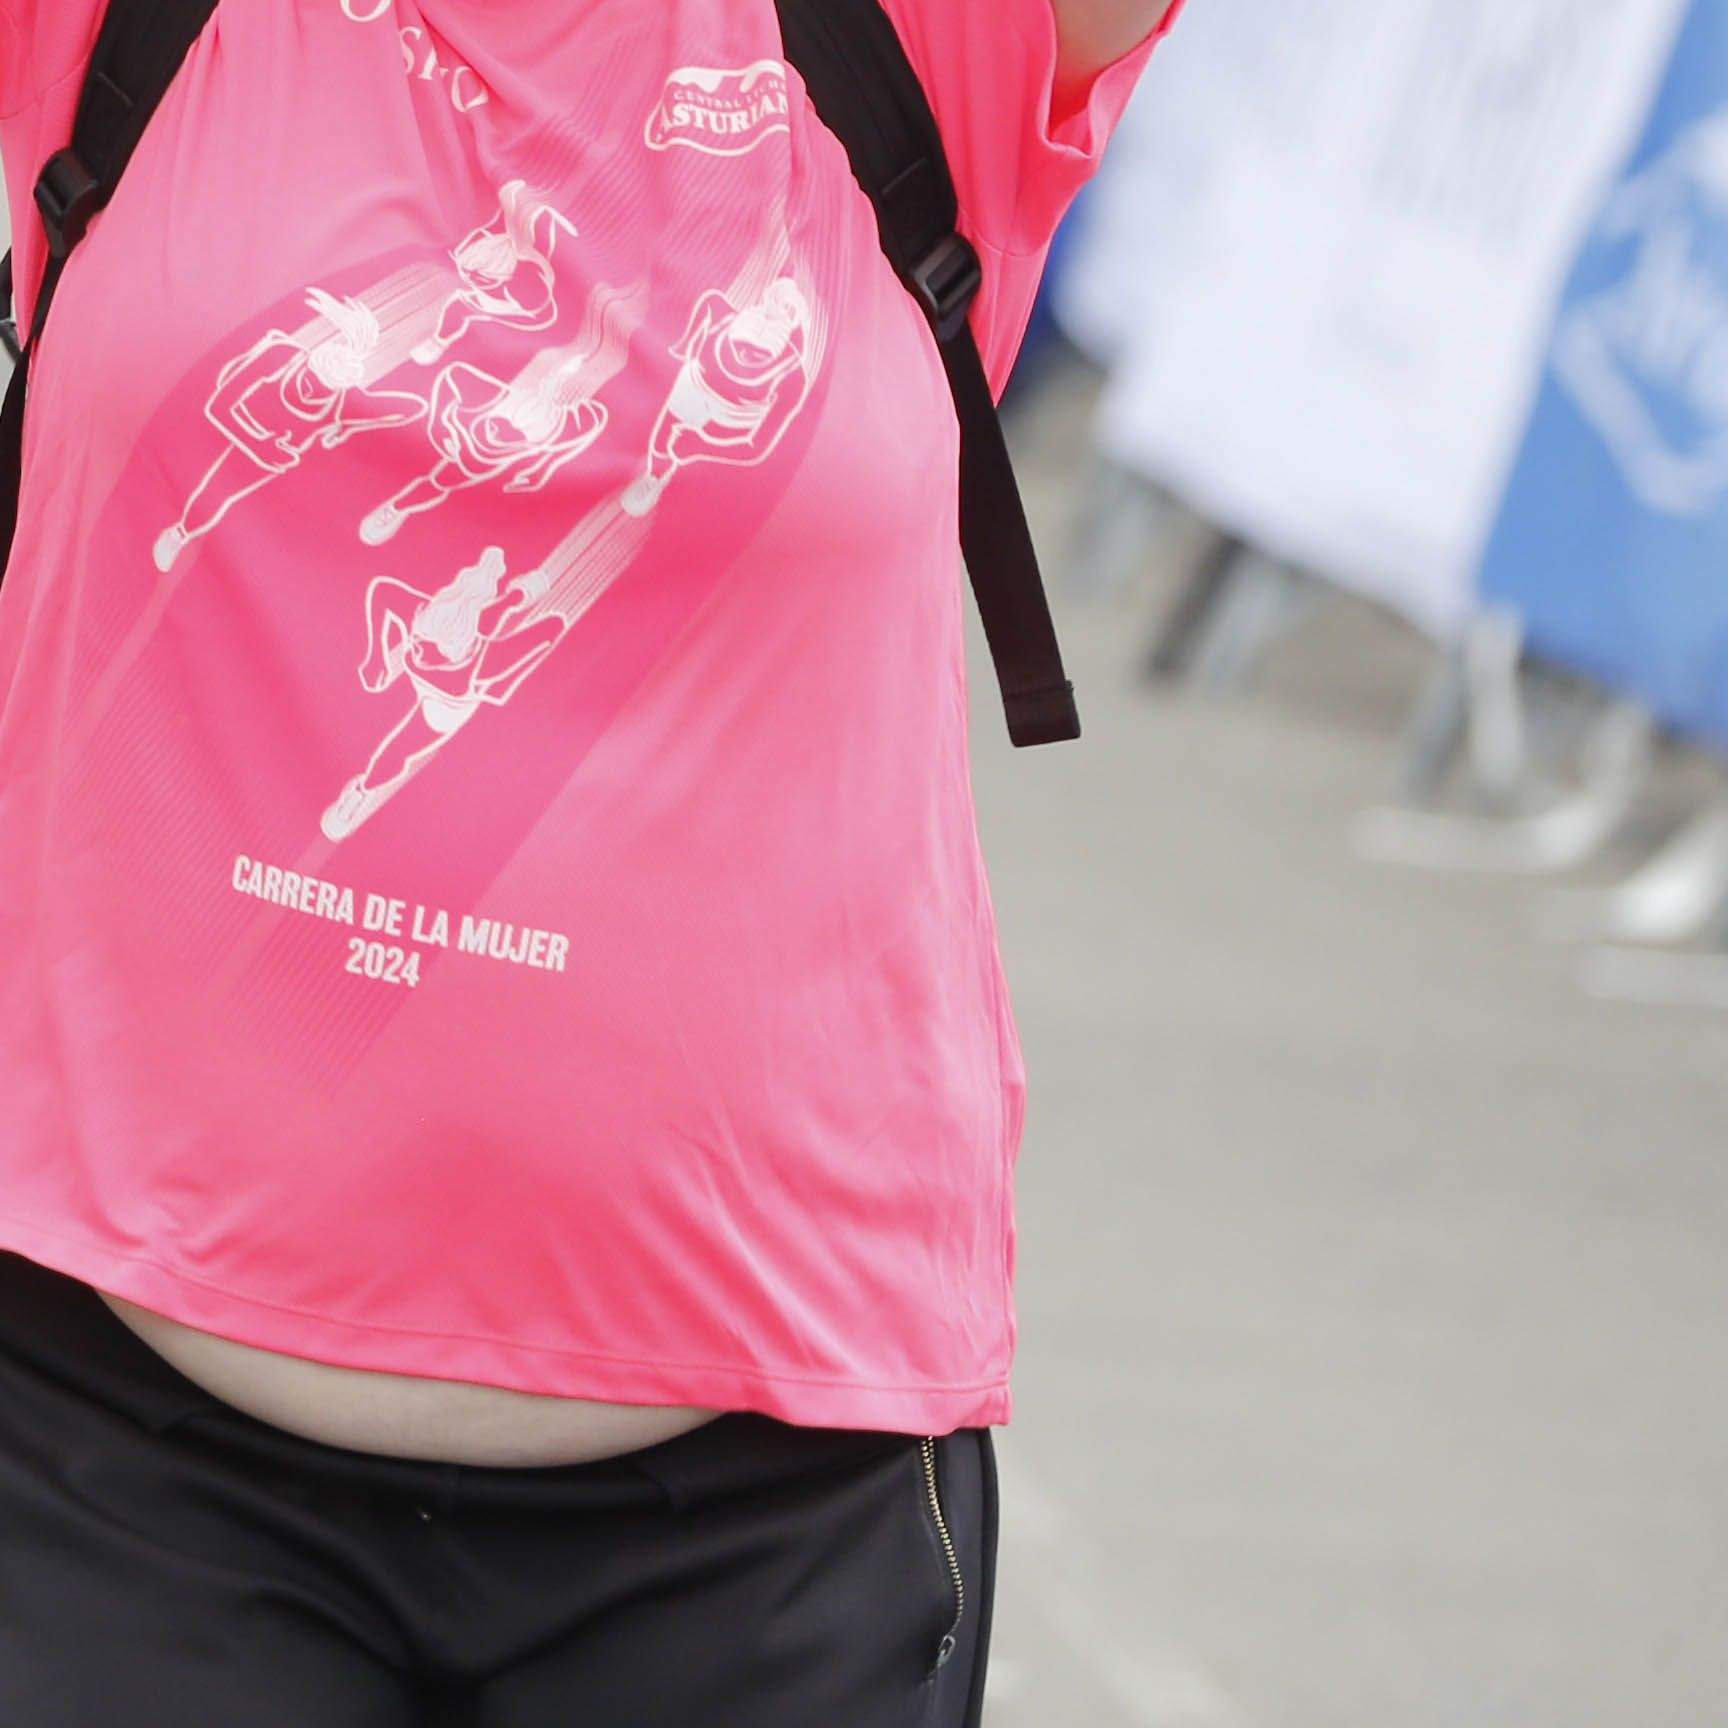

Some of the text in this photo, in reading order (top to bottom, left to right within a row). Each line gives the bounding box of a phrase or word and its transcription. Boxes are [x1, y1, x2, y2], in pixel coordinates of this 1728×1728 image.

[232, 854, 570, 972] CARRERA DE LA MUJER
[345, 937, 421, 987] 2024
